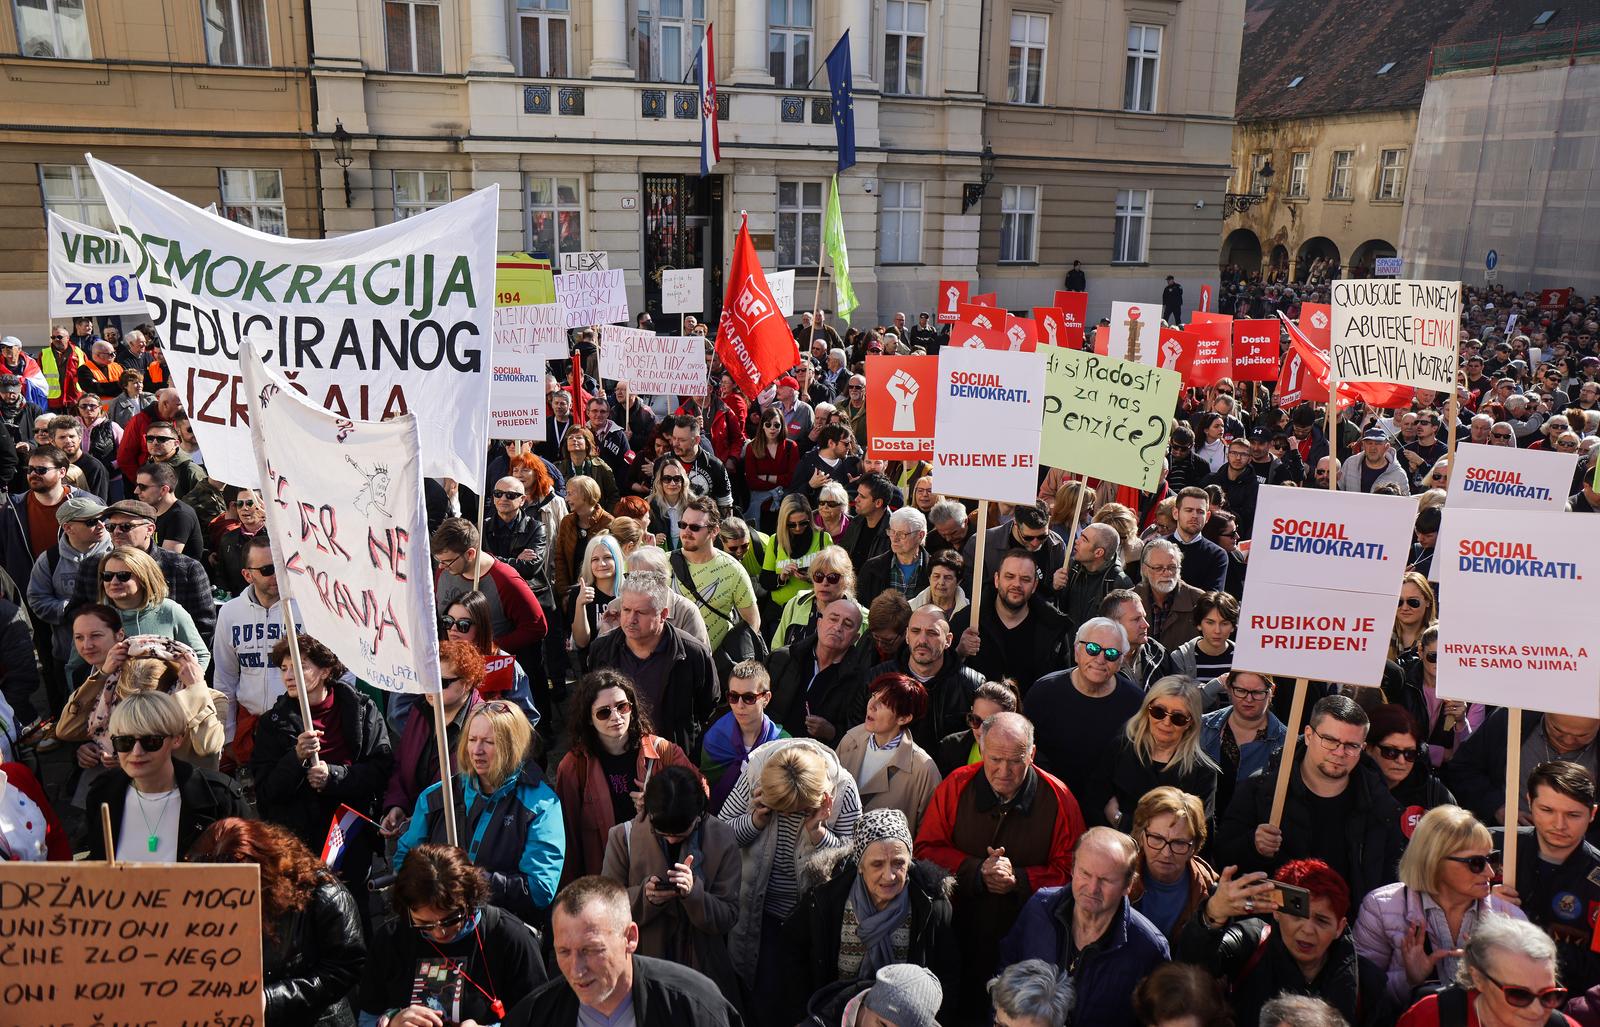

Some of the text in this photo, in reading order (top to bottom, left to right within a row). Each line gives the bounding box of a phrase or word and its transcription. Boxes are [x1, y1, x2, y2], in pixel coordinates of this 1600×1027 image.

[565, 252, 606, 271] LEX
[119, 225, 477, 320] DEMOKRACIJA
[65, 282, 104, 305] za
[497, 292, 521, 304] 194
[1334, 283, 1458, 313] QUOUSQUE TANDEM
[683, 338, 697, 353] JE
[1250, 345, 1260, 355] je
[626, 356, 658, 370] DOSTA
[730, 335, 761, 384] FRONTA
[1235, 356, 1275, 366] pljačke!
[1334, 344, 1409, 380] PATIENTIA
[493, 366, 523, 375] SOCIJAL
[493, 374, 539, 383] DEMOKRATI.
[951, 371, 1003, 387] SOCIJAL
[1065, 358, 1080, 378] si
[1084, 356, 1162, 394] Radosti
[950, 385, 1031, 404] DEMOKRATI.
[1074, 385, 1141, 414] za nas
[491, 408, 539, 419] RUBIKON JE
[873, 437, 935, 452] Dosta je!
[938, 453, 1033, 467] VRIJEME JE!
[1465, 467, 1524, 485] SOCIJAL
[1463, 479, 1552, 501] DEMOKRATI.
[1272, 518, 1349, 541] SOCIJAL
[368, 525, 408, 582] NE
[1270, 534, 1388, 561] DEMOKRATI.
[1459, 540, 1537, 560] SOCIJAL
[1459, 556, 1582, 580] DEMOKRATI.
[1251, 616, 1375, 632] RUBIKON JE
[1261, 635, 1367, 652] PRIJEĐEN!
[1444, 644, 1588, 658] HRVATSKA SVIMA, A
[485, 656, 514, 673] SDP
[1459, 657, 1577, 671] NE SAMO NJIMA!
[0, 877, 256, 910] DRŽAVU NE MOGU
[0, 914, 238, 939] UNIŠTITI ONI KOJI
[85, 945, 138, 963] ZLO
[4, 984, 56, 1005] ONI
[75, 982, 126, 1001] KOJI
[140, 980, 178, 997] TO
